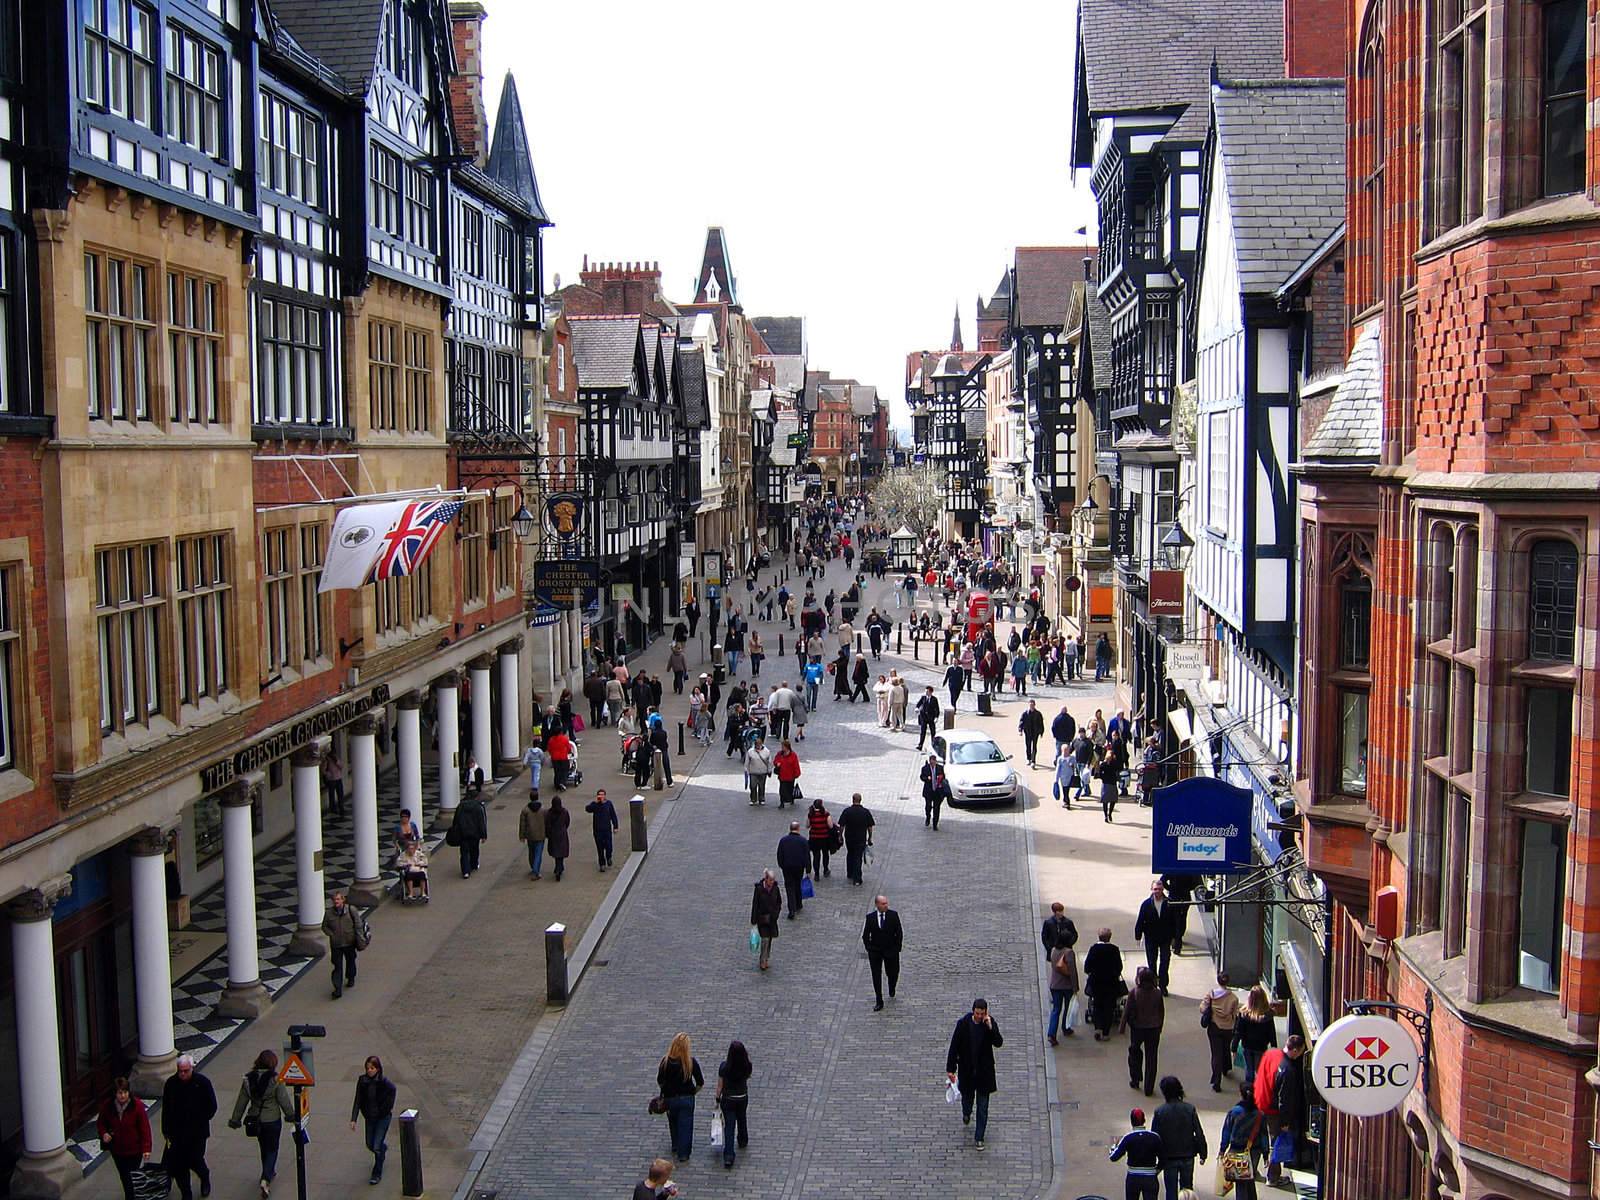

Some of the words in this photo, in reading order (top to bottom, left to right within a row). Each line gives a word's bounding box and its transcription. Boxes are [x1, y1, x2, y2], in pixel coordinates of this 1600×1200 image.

[1118, 512, 1127, 553] NEXT
[559, 563, 577, 571] THE
[545, 571, 589, 579] CHESTER
[1150, 598, 1182, 609] Thorntons
[1172, 651, 1200, 661] Russell
[204, 759, 234, 791] THE
[238, 730, 292, 775] CHESTER
[294, 699, 357, 747] GROSVENOR
[1166, 822, 1239, 838] Littlewoods
[1183, 842, 1220, 856] index
[1324, 1063, 1409, 1089] HSBC
